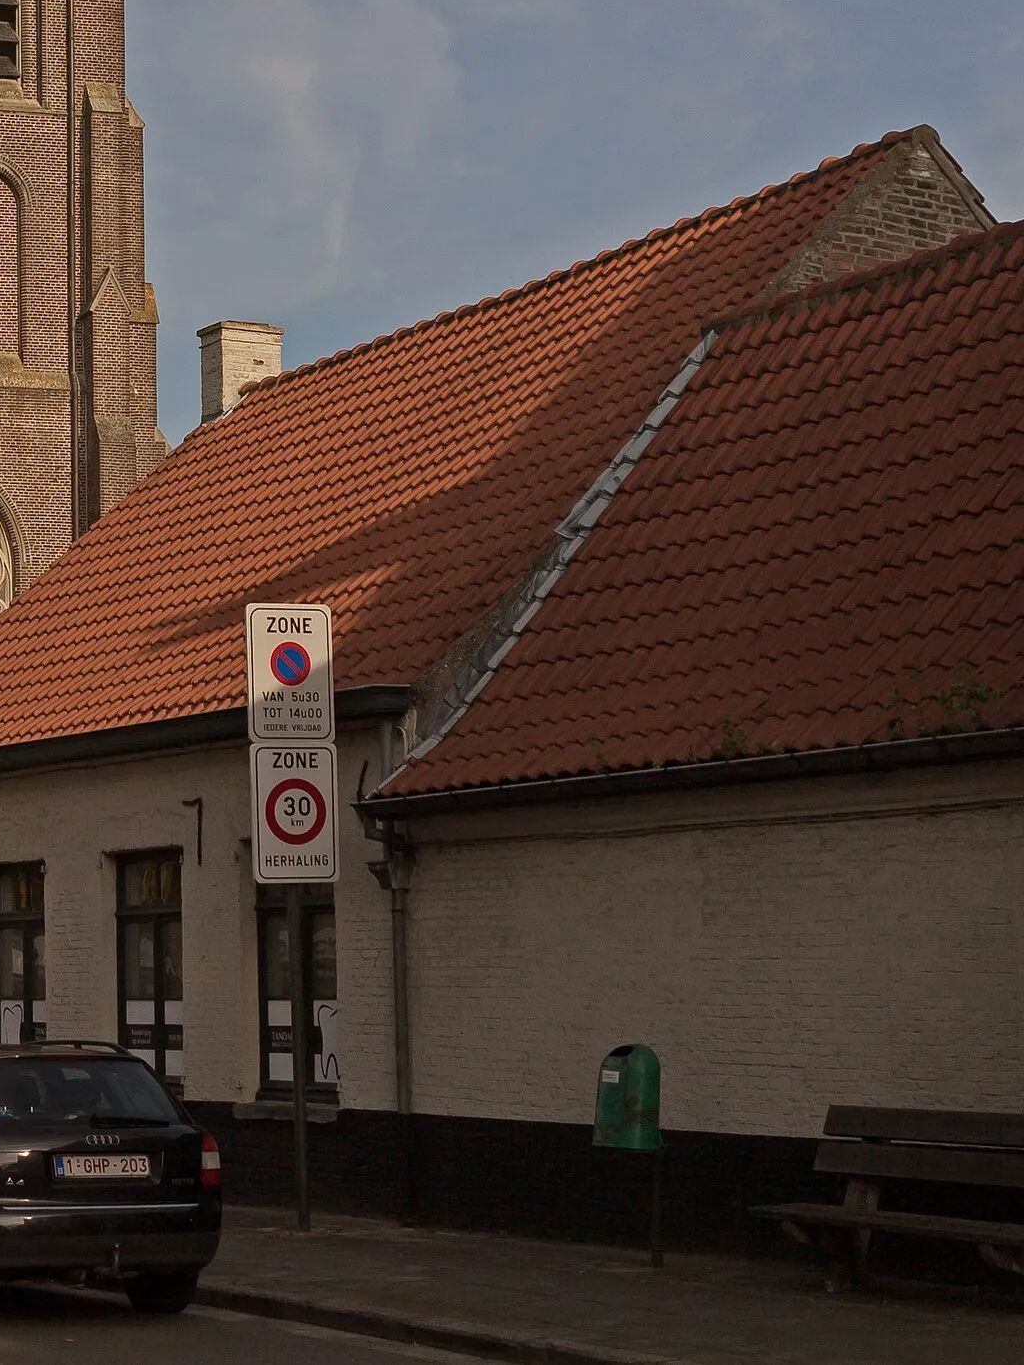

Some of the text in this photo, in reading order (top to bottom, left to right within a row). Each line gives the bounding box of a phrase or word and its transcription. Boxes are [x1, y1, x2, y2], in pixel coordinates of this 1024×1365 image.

[266, 617, 313, 634] ZONE
[262, 691, 320, 703] VAN 5u30
[262, 707, 323, 719] TOT 14u00
[263, 724, 322, 732] IEDERE VRIJDAG
[272, 752, 319, 769] ZONE
[283, 796, 311, 817] 30
[290, 818, 304, 827] km
[265, 854, 329, 867] HERHALING
